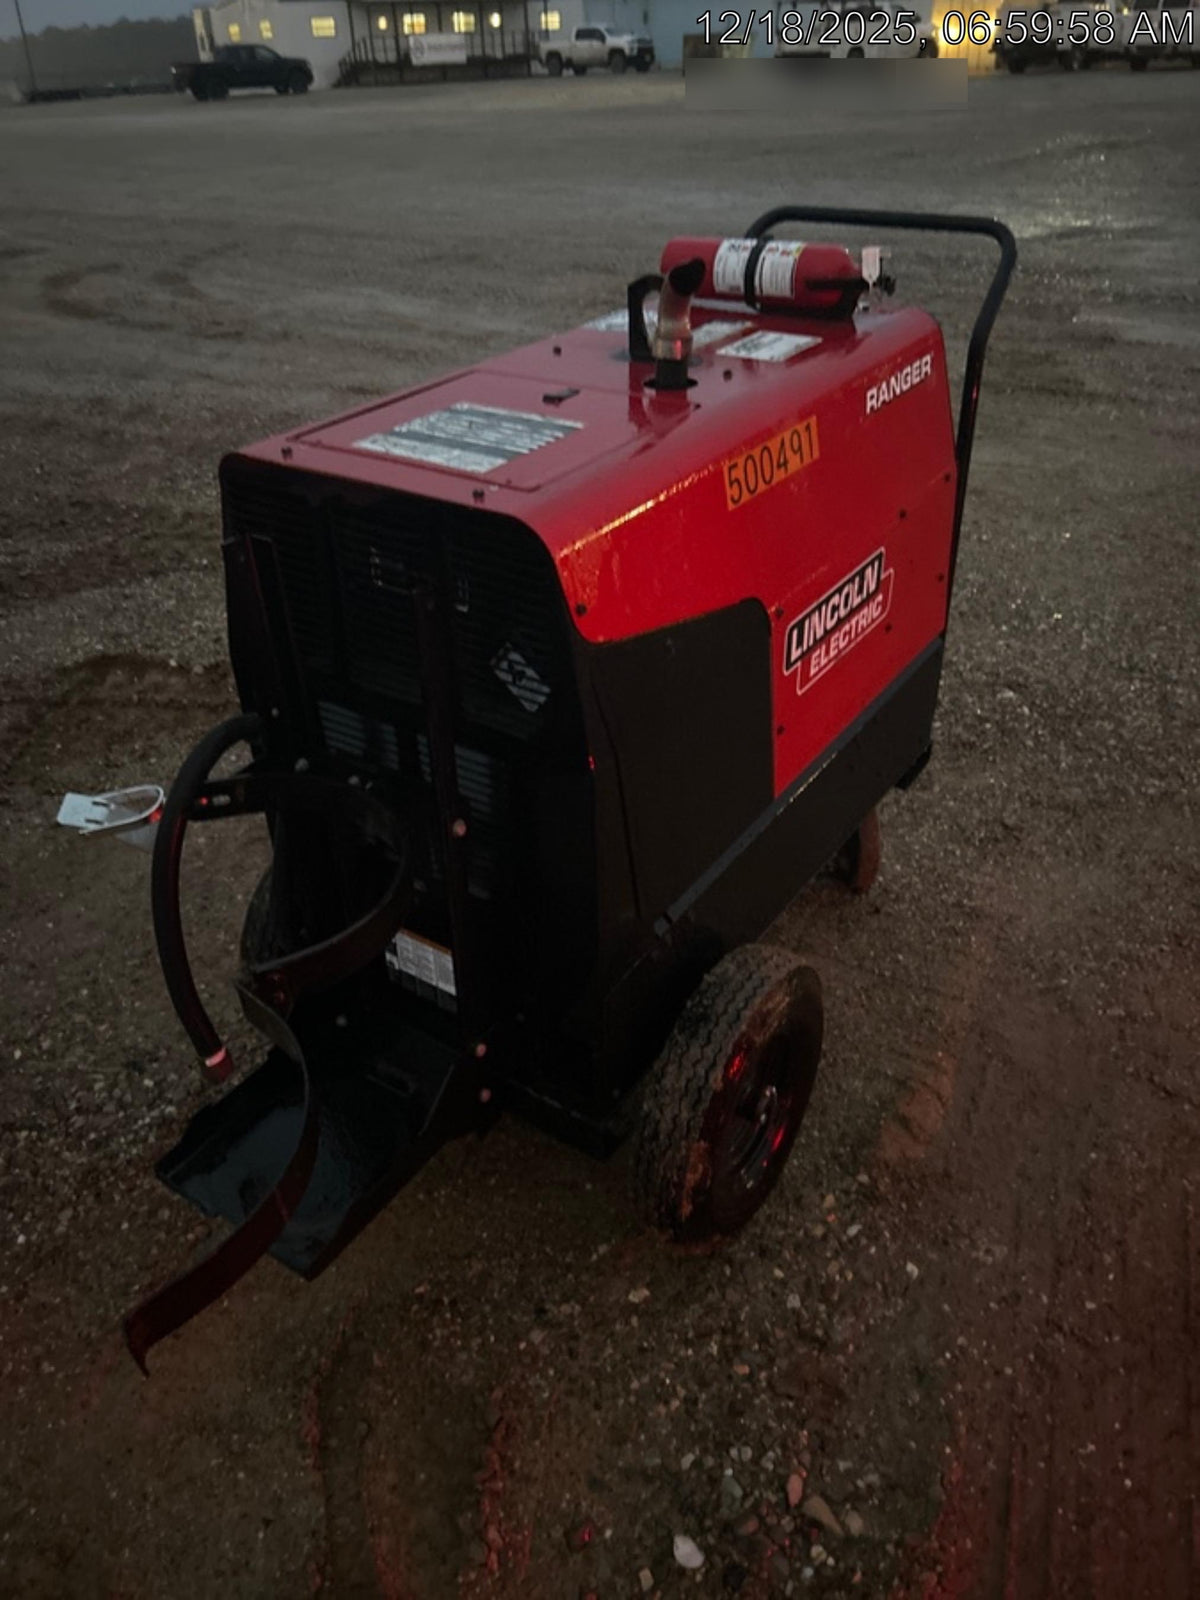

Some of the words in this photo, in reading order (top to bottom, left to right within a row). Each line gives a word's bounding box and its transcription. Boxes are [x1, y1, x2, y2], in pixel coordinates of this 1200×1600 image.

[866, 354, 933, 414] RANGER
[728, 423, 815, 506] 500491
[788, 558, 880, 664] LINCOLN
[811, 596, 884, 676] ELECTRIC
